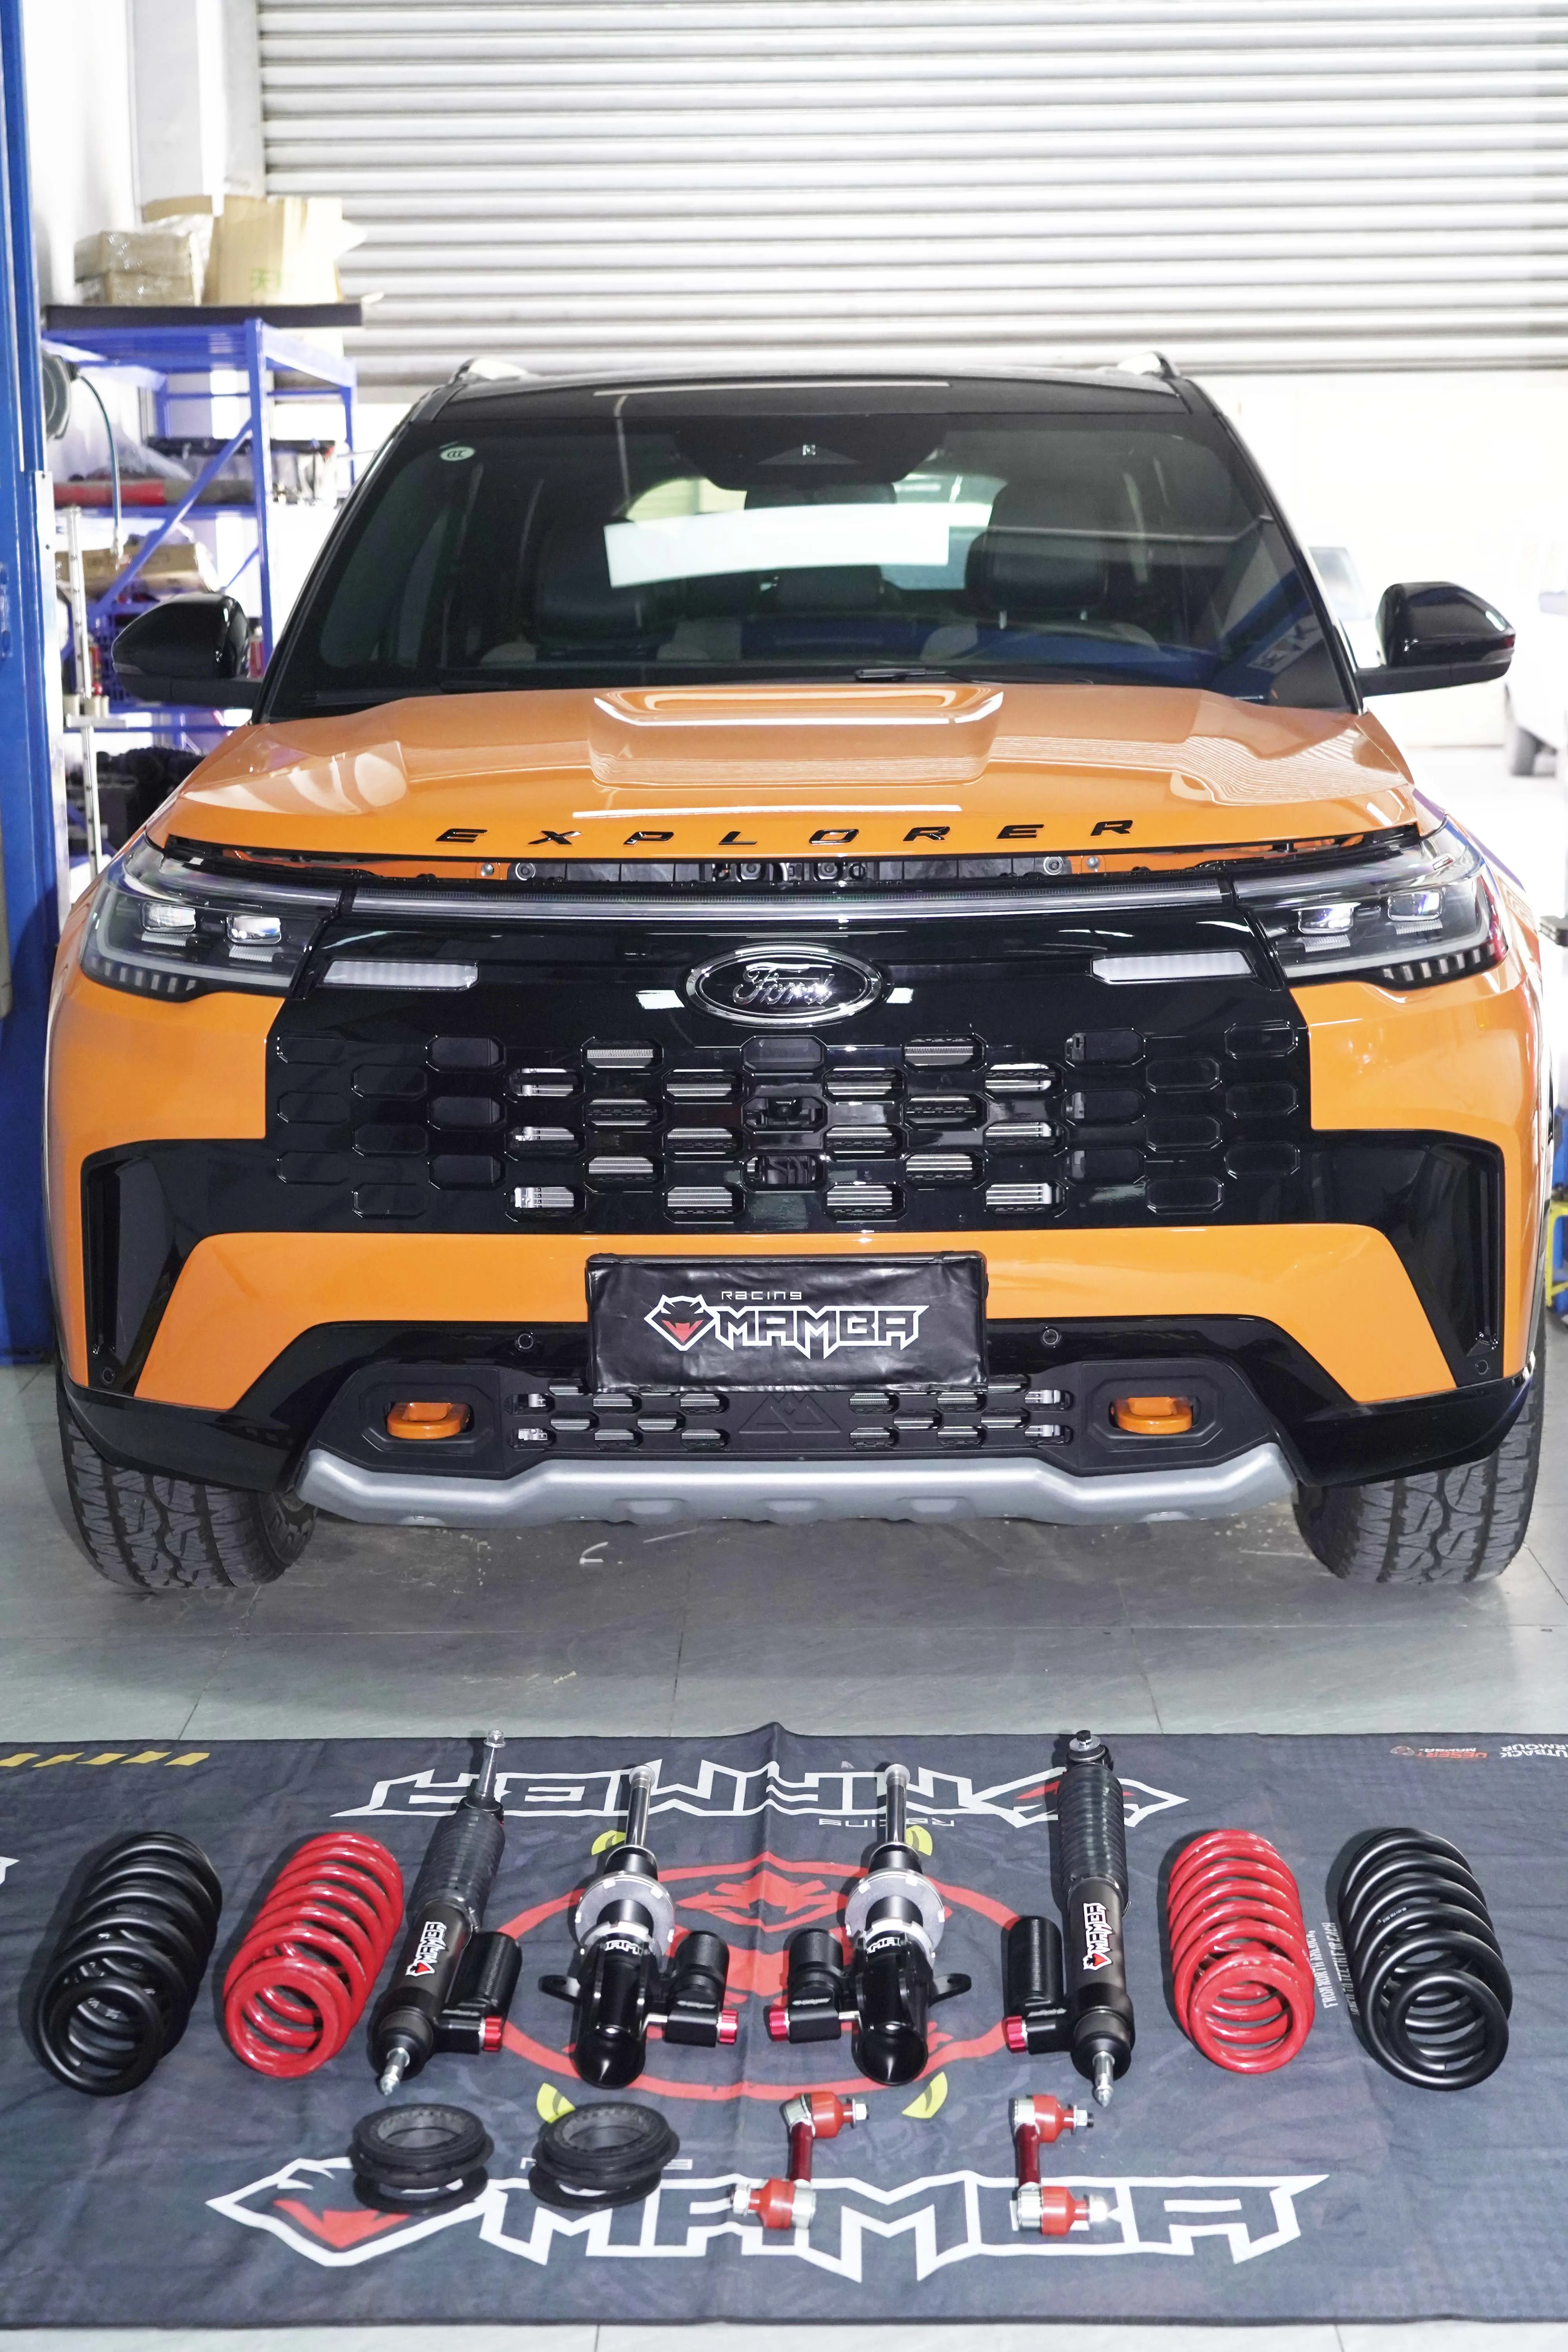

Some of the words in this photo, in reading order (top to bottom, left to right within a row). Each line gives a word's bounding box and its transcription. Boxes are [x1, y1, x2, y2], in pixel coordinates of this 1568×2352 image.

[435, 819, 1133, 846] EXPLORER
[733, 962, 835, 1005] Ford
[715, 1305, 929, 1359] MAMBA
[1499, 1750, 1568, 1758] UTBACK
[1501, 1743, 1568, 1752] RMOUR
